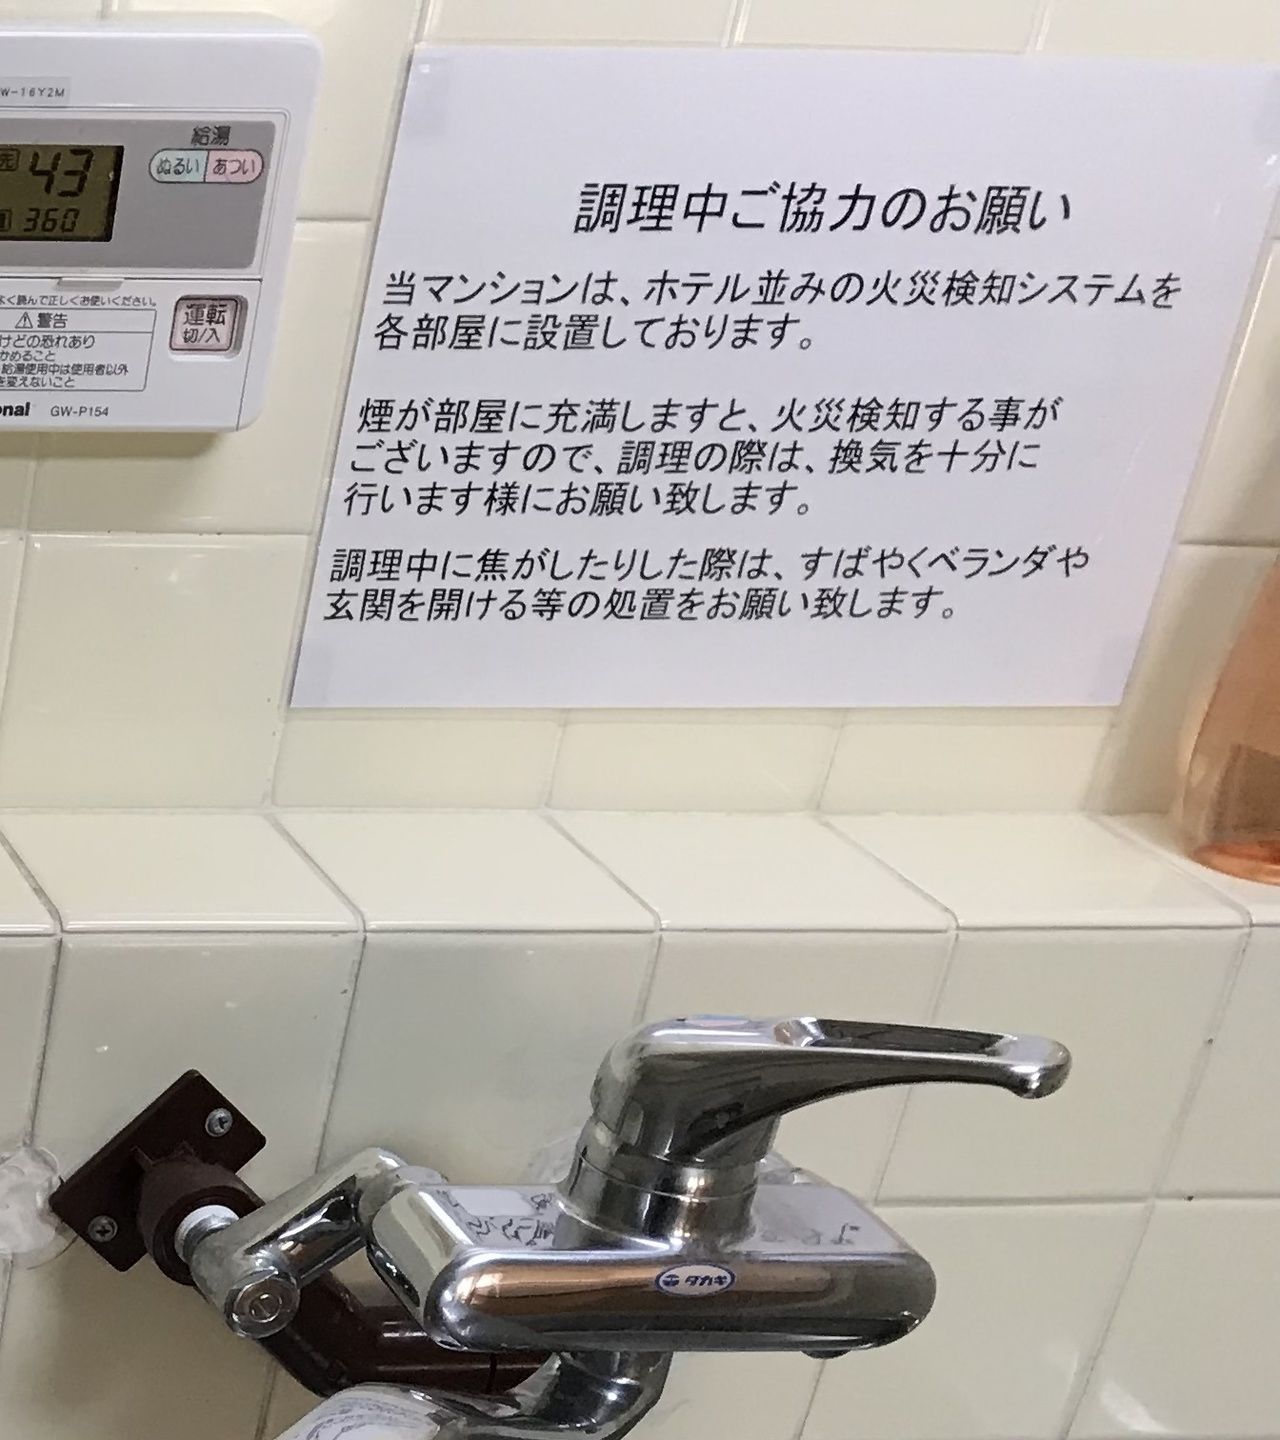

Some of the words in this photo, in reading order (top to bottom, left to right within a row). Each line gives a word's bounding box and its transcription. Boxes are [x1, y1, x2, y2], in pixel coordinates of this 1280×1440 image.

[191, 126, 231, 146] 給湯
[29, 149, 94, 197] 43
[157, 158, 199, 175] ぬるい
[213, 158, 254, 175] あつい
[23, 208, 80, 233] 360
[574, 181, 1070, 234] 調理中ご協力のお願い
[383, 269, 1181, 308] 当マンションは、ホテル並みの火災検知システムを
[37, 313, 67, 328] 警告
[184, 303, 228, 326] 運転
[375, 313, 811, 350] 各部屋に設置しております。
[51, 406, 108, 417] GW-P154
[355, 396, 1060, 434] 煙が部屋に充満しますと、火災検知する事が
[348, 439, 1040, 475] ございますので、調理の際は、換気を十分に
[344, 481, 808, 516] 行います様にお願い致します。
[330, 546, 1089, 582] 調理中に焦がしたりした際は、すばやくベランダや
[324, 586, 953, 621] 玄関を開ける等の処置をお願い致します。
[685, 1276, 728, 1286] タカギ
